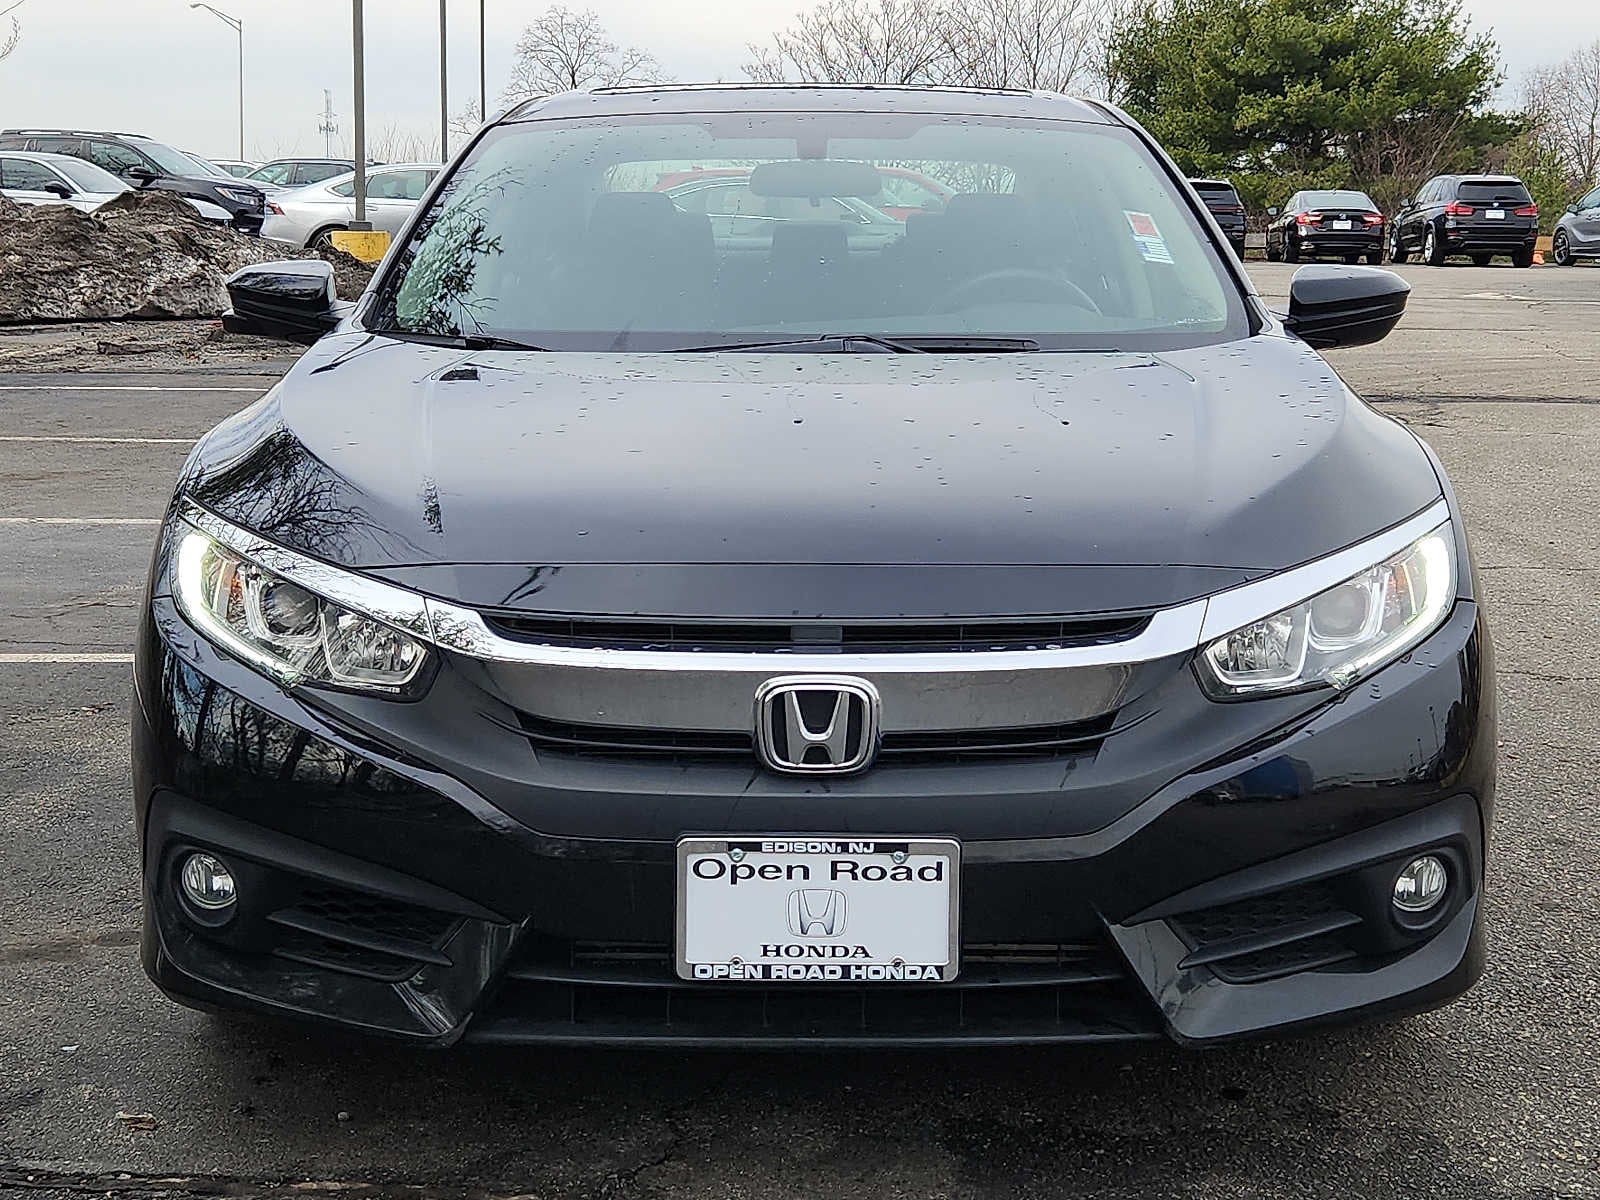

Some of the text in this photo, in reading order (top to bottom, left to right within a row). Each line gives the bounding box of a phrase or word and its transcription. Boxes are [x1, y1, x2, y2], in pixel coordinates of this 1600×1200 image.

[848, 842, 875, 853] NJ
[693, 858, 943, 885] Open Road
[760, 944, 873, 958] HONDA
[695, 964, 941, 980] OPEN ROAD HONDA
